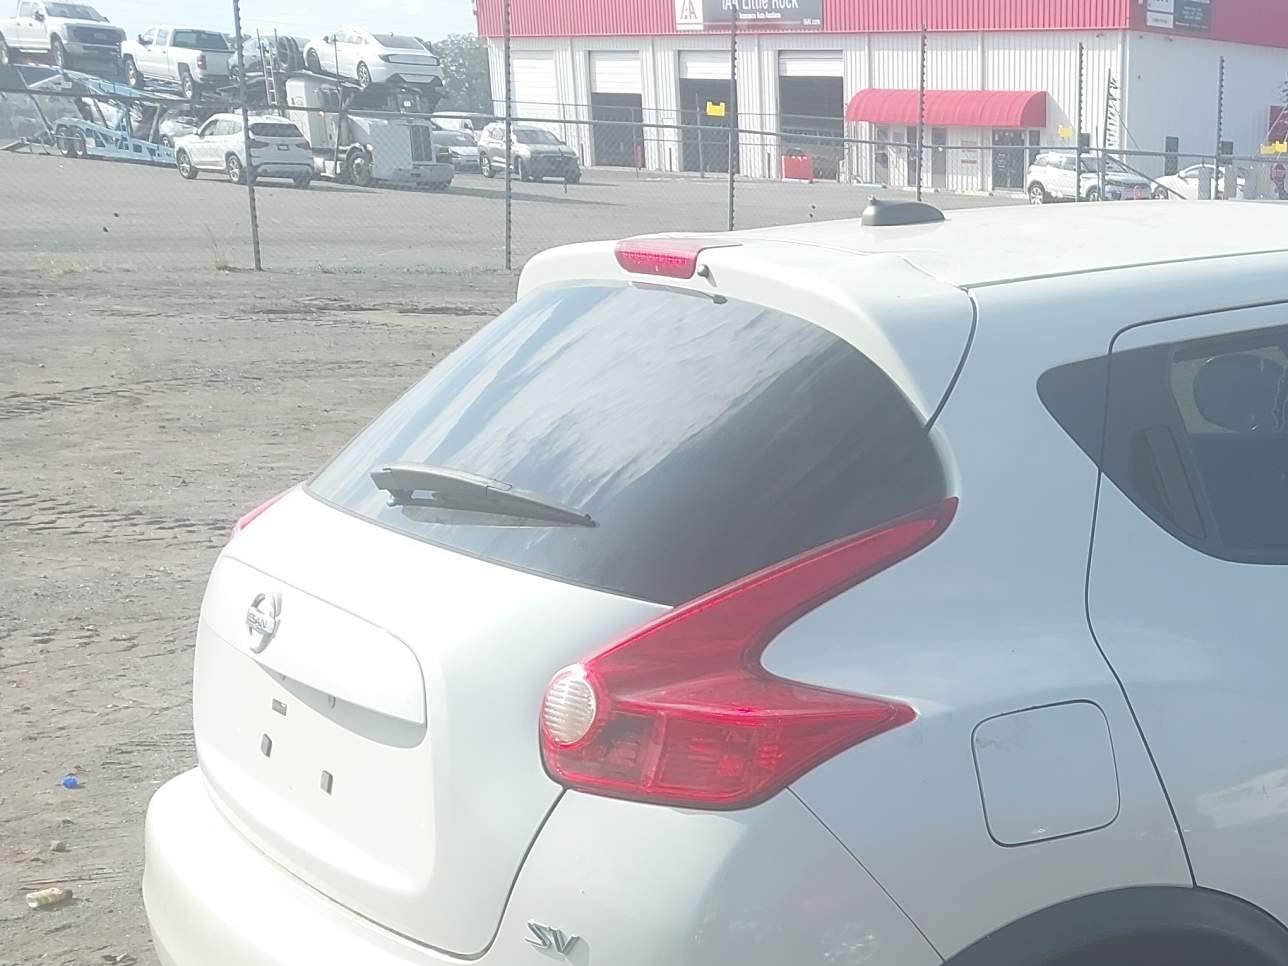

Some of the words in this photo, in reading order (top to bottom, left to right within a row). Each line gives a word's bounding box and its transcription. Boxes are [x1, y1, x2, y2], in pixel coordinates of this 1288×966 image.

[742, 0, 768, 10] Little
[771, 0, 799, 9] Rock
[525, 921, 581, 956] SV
